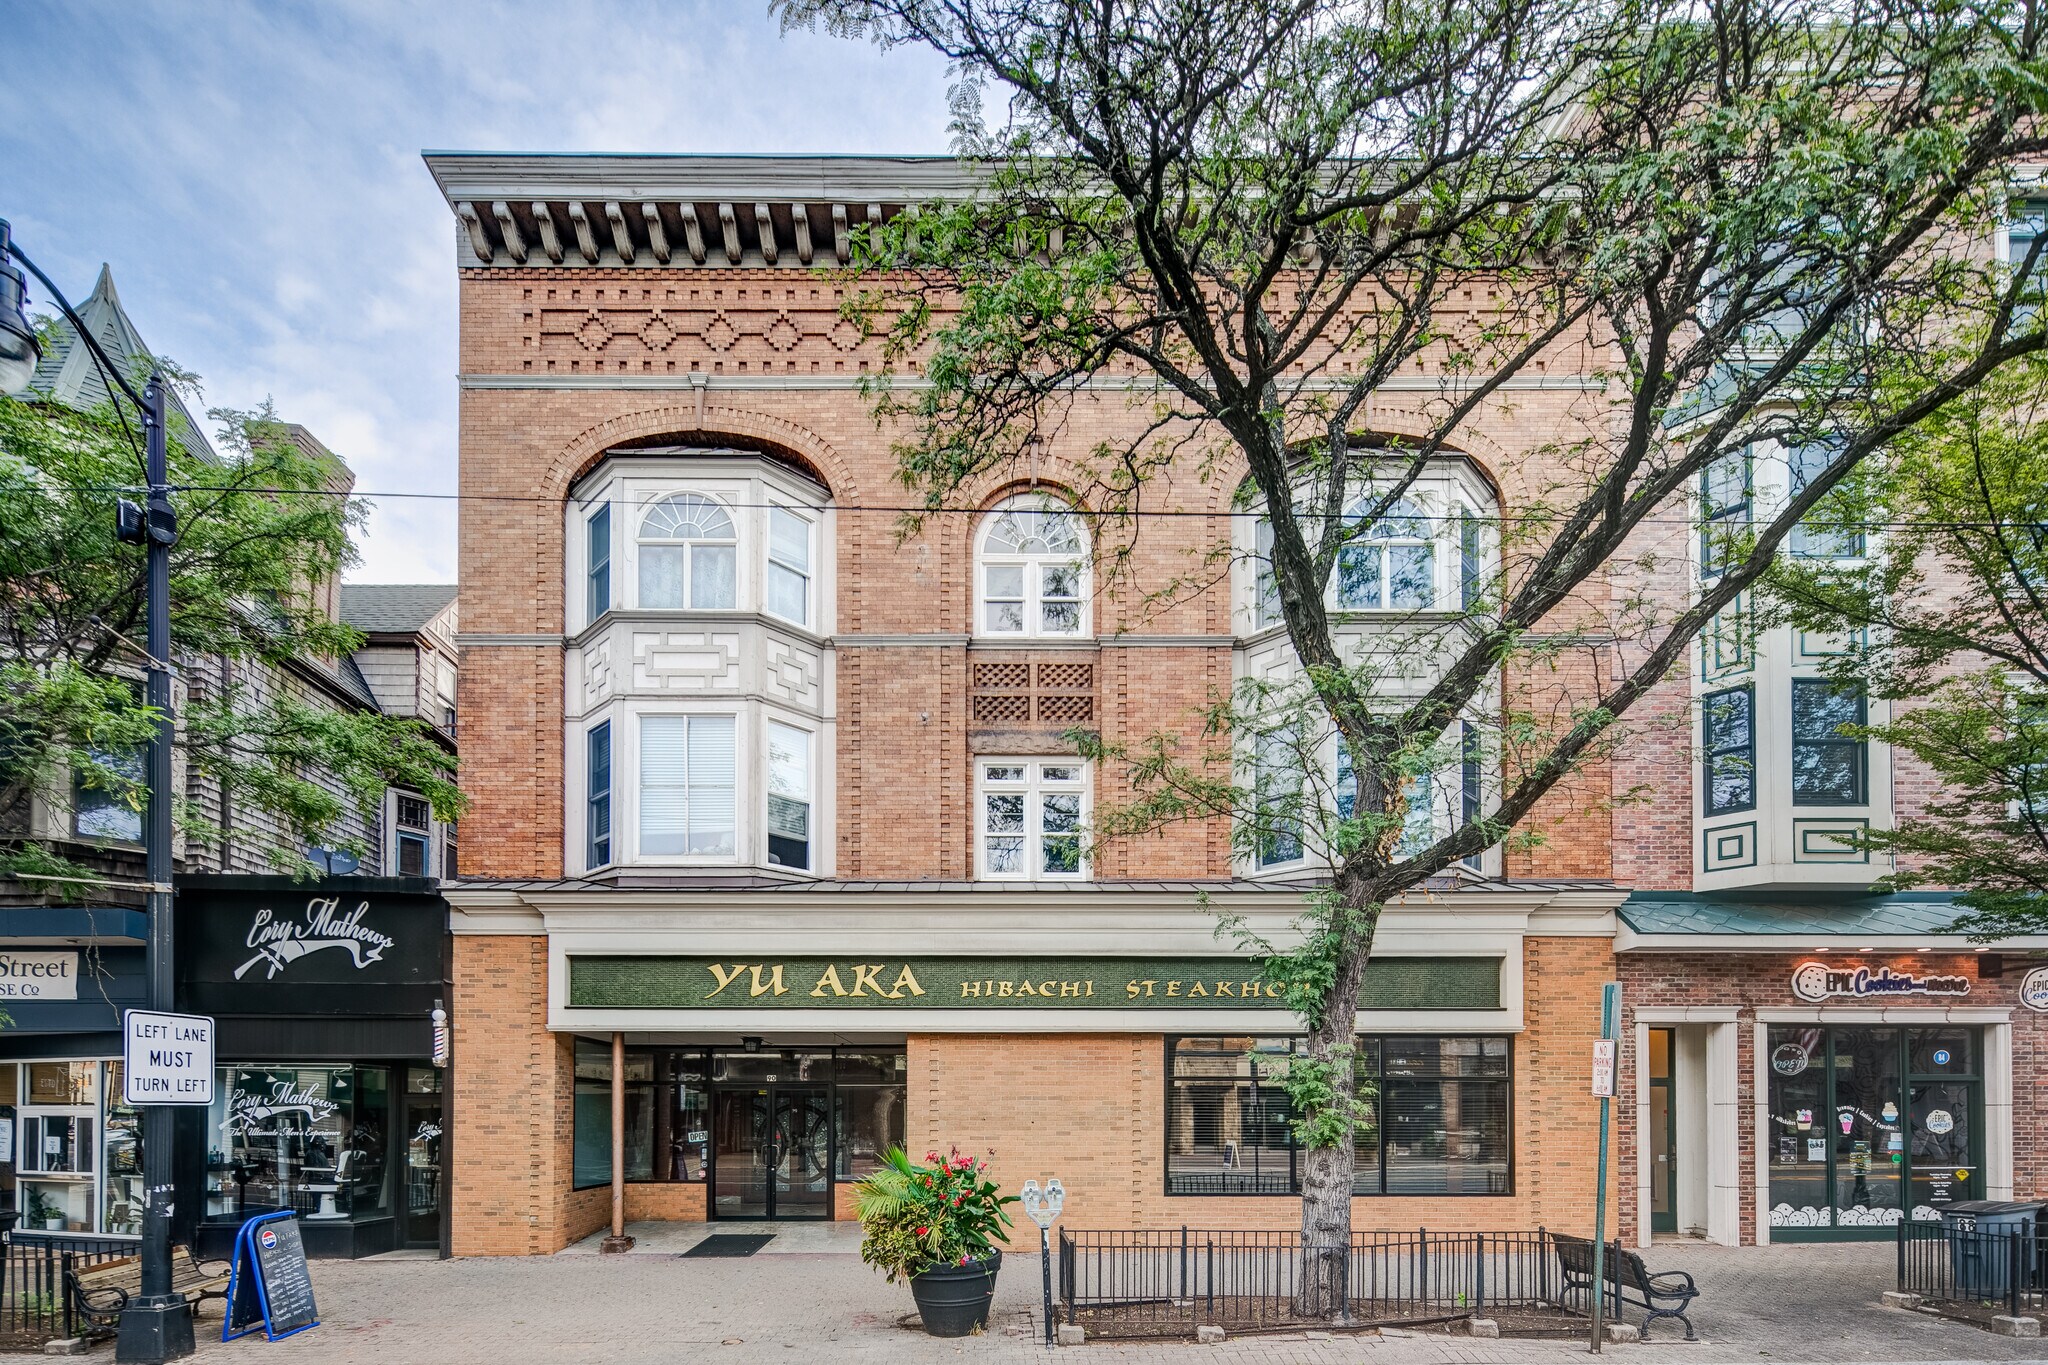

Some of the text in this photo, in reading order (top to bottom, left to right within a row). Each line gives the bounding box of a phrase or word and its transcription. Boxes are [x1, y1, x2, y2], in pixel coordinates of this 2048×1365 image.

[246, 897, 395, 958] Cory Mathews
[0, 954, 69, 978] Street
[704, 963, 1310, 999] YU AKA HIBACHI STEAKHO
[1825, 972, 1853, 992] EPIC
[1855, 969, 1912, 994] Cookies
[136, 1024, 206, 1042] LEFT LANE
[150, 1050, 192, 1068] MUST
[1599, 1045, 1608, 1056] NO
[135, 1077, 206, 1092] TURN LEFT
[227, 1081, 339, 1116] Cory Mathews
[229, 1127, 341, 1142] The Ultimate Men's Experience
[690, 1132, 708, 1141] OPEN
